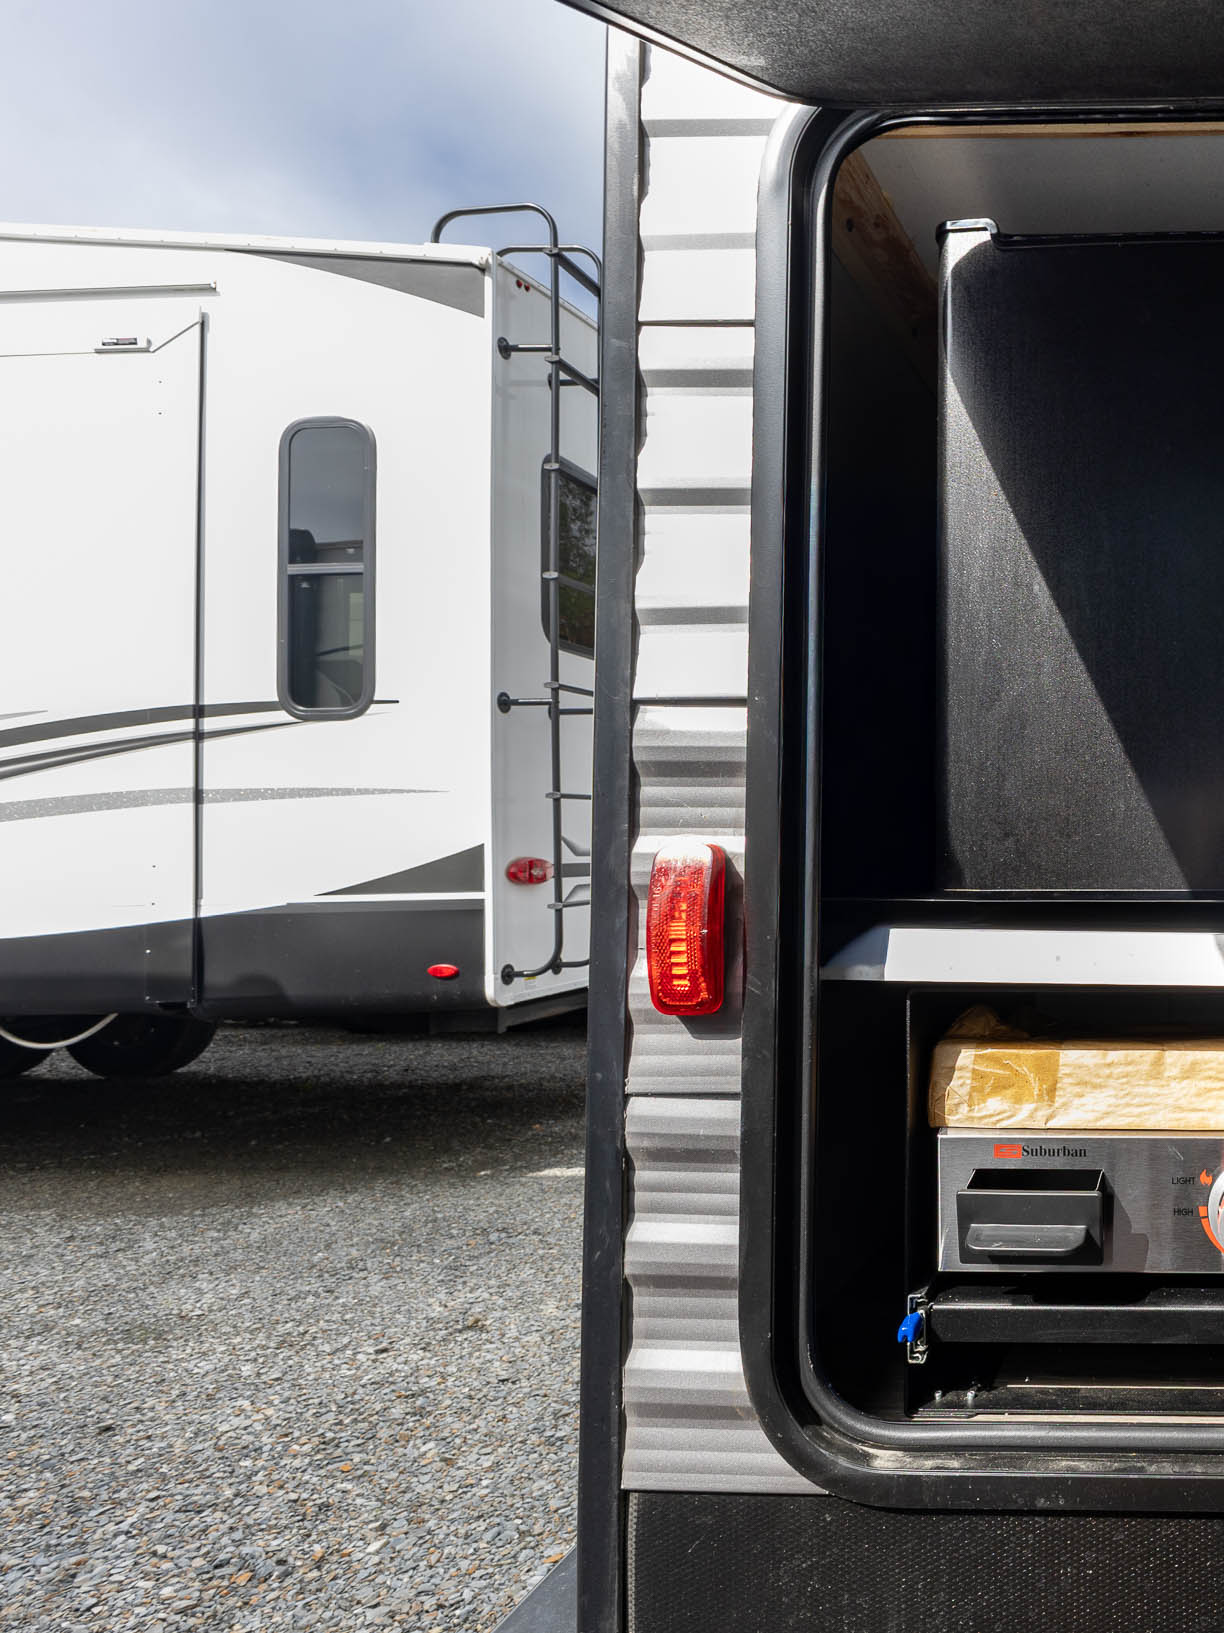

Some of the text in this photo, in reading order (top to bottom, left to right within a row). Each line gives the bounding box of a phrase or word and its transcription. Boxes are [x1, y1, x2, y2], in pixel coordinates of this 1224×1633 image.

[1021, 1144, 1087, 1158] Suburban
[1171, 1176, 1196, 1186] LIGHT
[1173, 1207, 1194, 1216] HIGH
